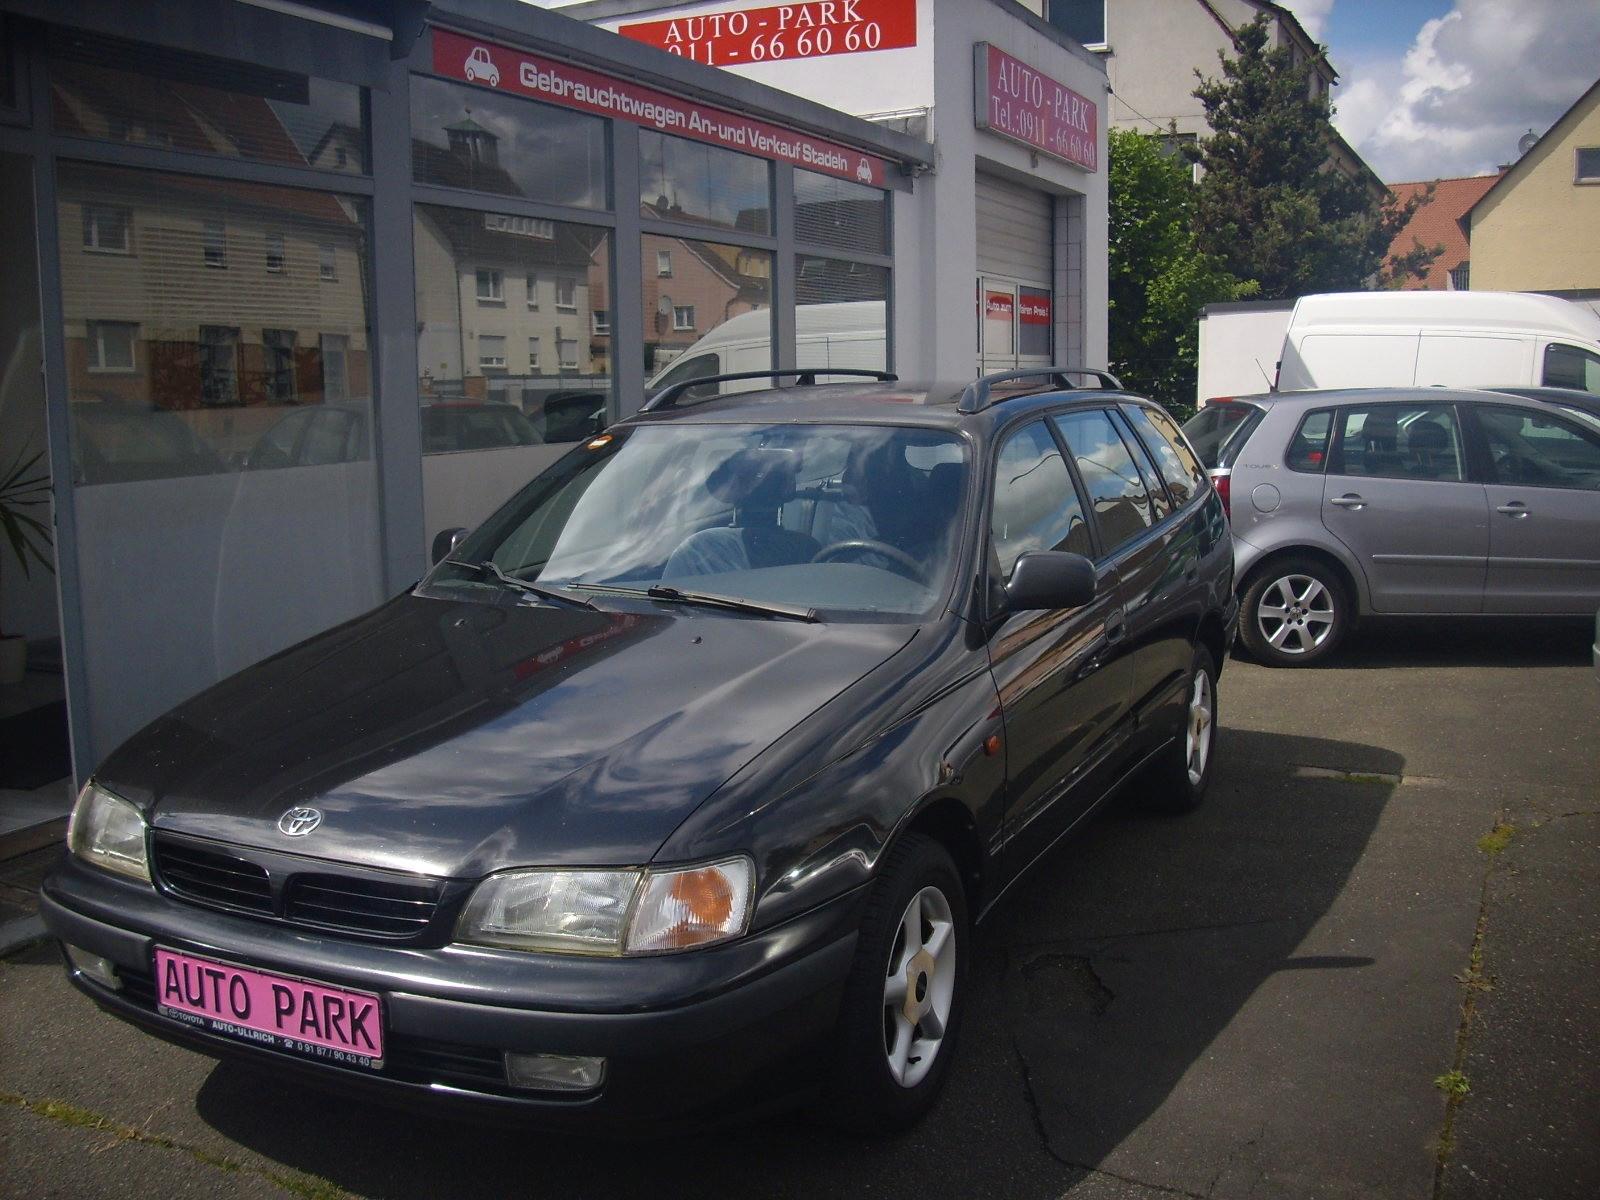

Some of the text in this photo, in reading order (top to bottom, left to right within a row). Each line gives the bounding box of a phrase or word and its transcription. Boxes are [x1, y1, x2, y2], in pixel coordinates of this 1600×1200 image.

[664, 12, 748, 44] AUTO
[778, 0, 864, 30] PARK
[751, 32, 784, 60] 66
[797, 28, 833, 56] 60
[845, 22, 881, 51] 60
[519, 62, 686, 128] Gebrauchtwagen
[748, 127, 800, 159] Verkauf
[802, 144, 848, 171] Stadeln
[998, 58, 1043, 108] AUTO
[1055, 87, 1090, 133] PARK
[165, 959, 376, 1050] AUTO PARK
[179, 1012, 205, 1026] TOYOTA
[212, 1020, 275, 1044] AUTO-ULLRICH
